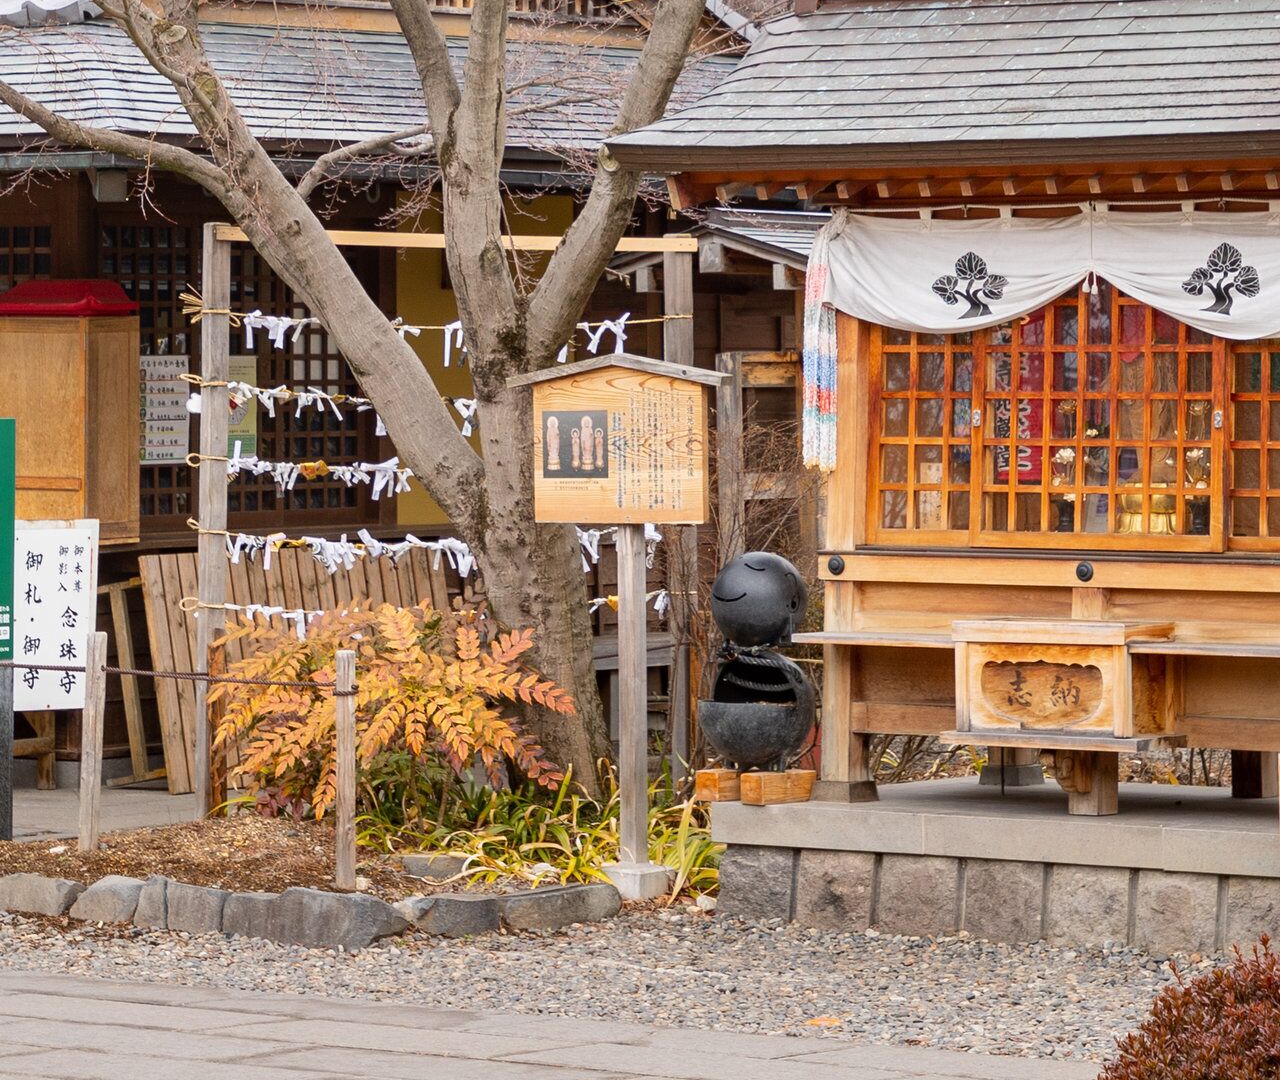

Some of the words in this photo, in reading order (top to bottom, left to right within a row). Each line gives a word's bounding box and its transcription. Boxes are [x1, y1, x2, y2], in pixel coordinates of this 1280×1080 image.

[57, 545, 70, 592] 御影入
[72, 544, 85, 593] 御本尊
[22, 550, 43, 690] 御札・御守
[59, 605, 78, 694] 念珠守
